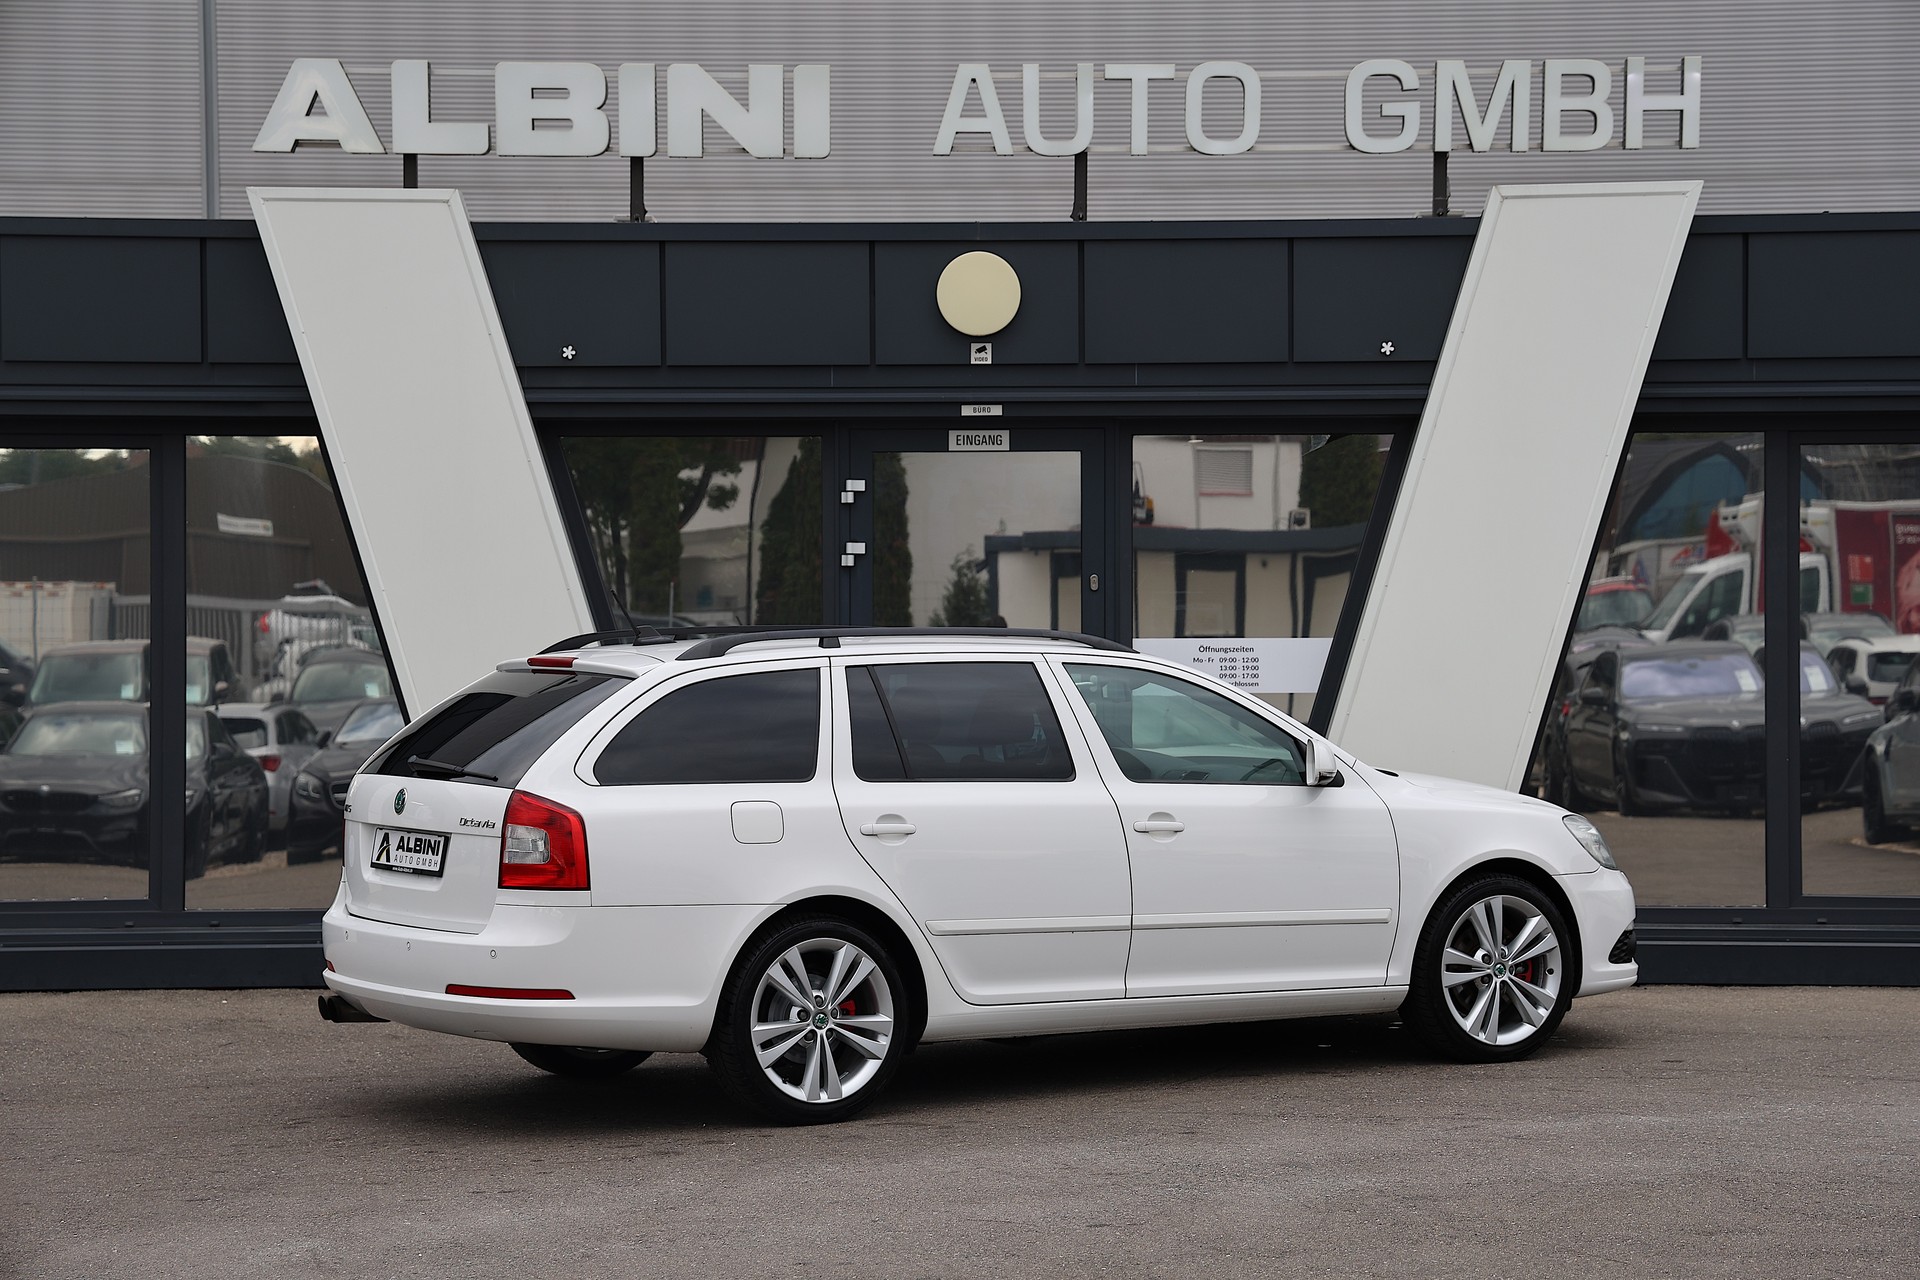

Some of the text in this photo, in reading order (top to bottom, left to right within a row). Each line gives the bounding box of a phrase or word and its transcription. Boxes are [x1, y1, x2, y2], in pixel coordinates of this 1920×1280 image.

[252, 55, 1703, 160] ALBINI AUTO GMBH
[955, 434, 1003, 446] EINGANG
[1198, 645, 1254, 654] Öffnungszeiten
[459, 817, 496, 829] Octavia
[396, 836, 440, 856] ALBINI
[394, 854, 438, 868] AUTO GMBH
